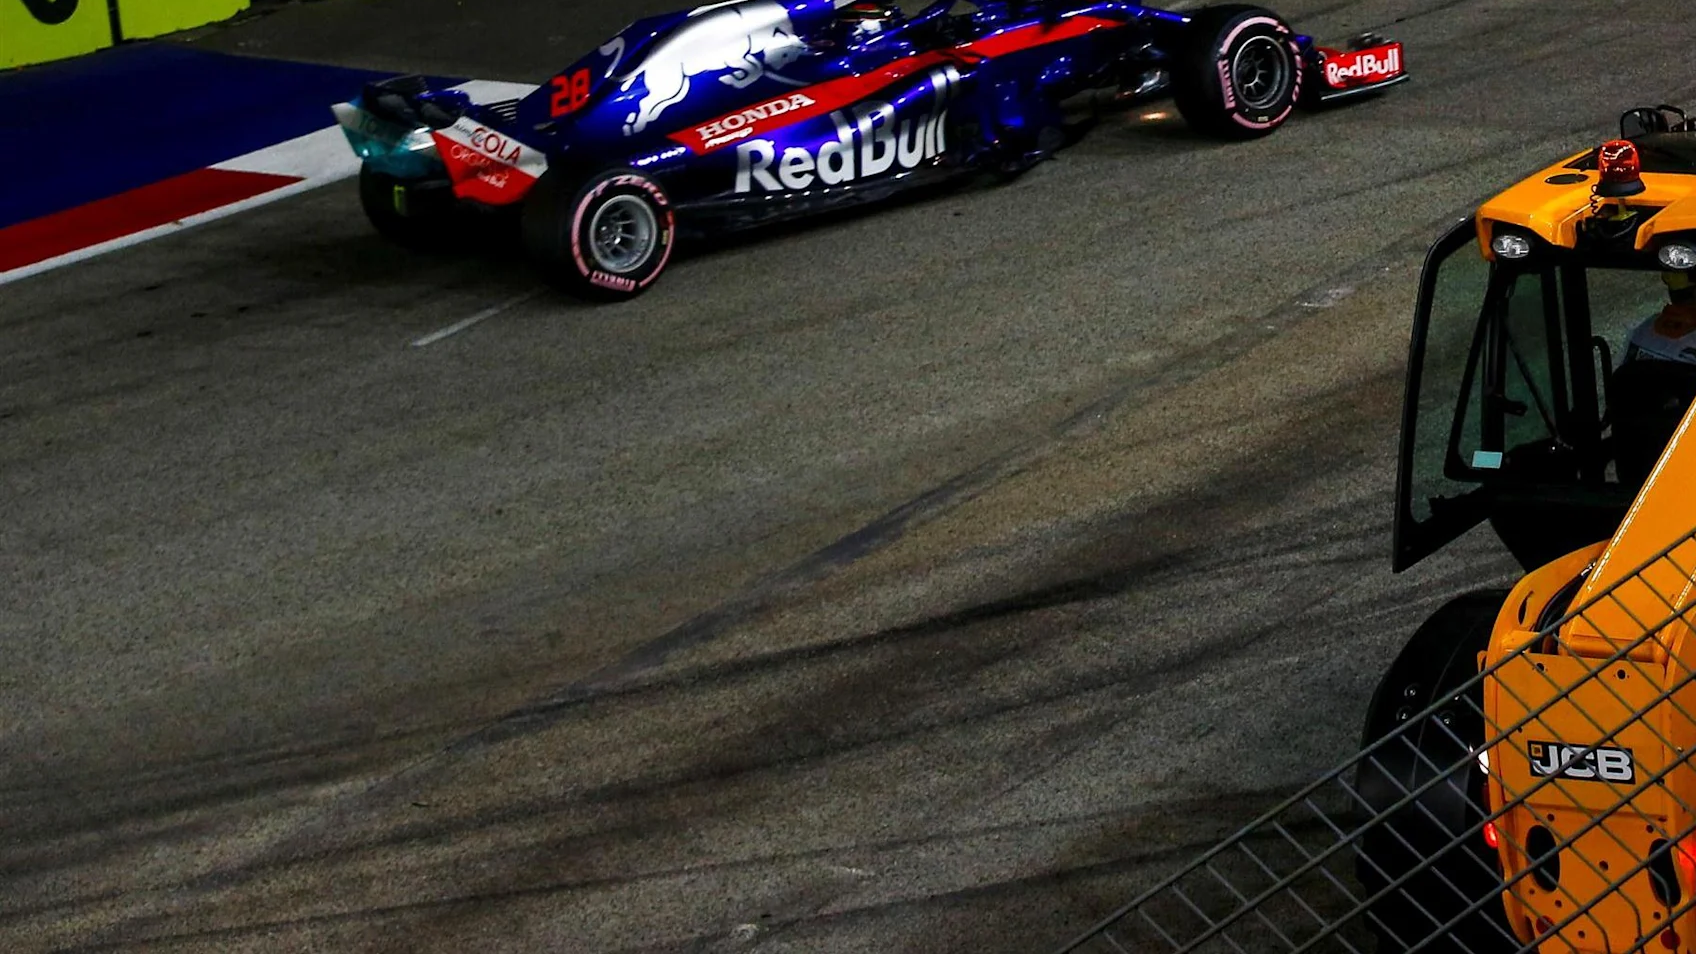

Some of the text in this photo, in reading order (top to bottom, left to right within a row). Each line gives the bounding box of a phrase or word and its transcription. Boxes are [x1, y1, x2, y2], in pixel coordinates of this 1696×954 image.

[695, 93, 817, 141] HONDA
[471, 127, 521, 164] COLA
[1532, 745, 1633, 781] JCB
